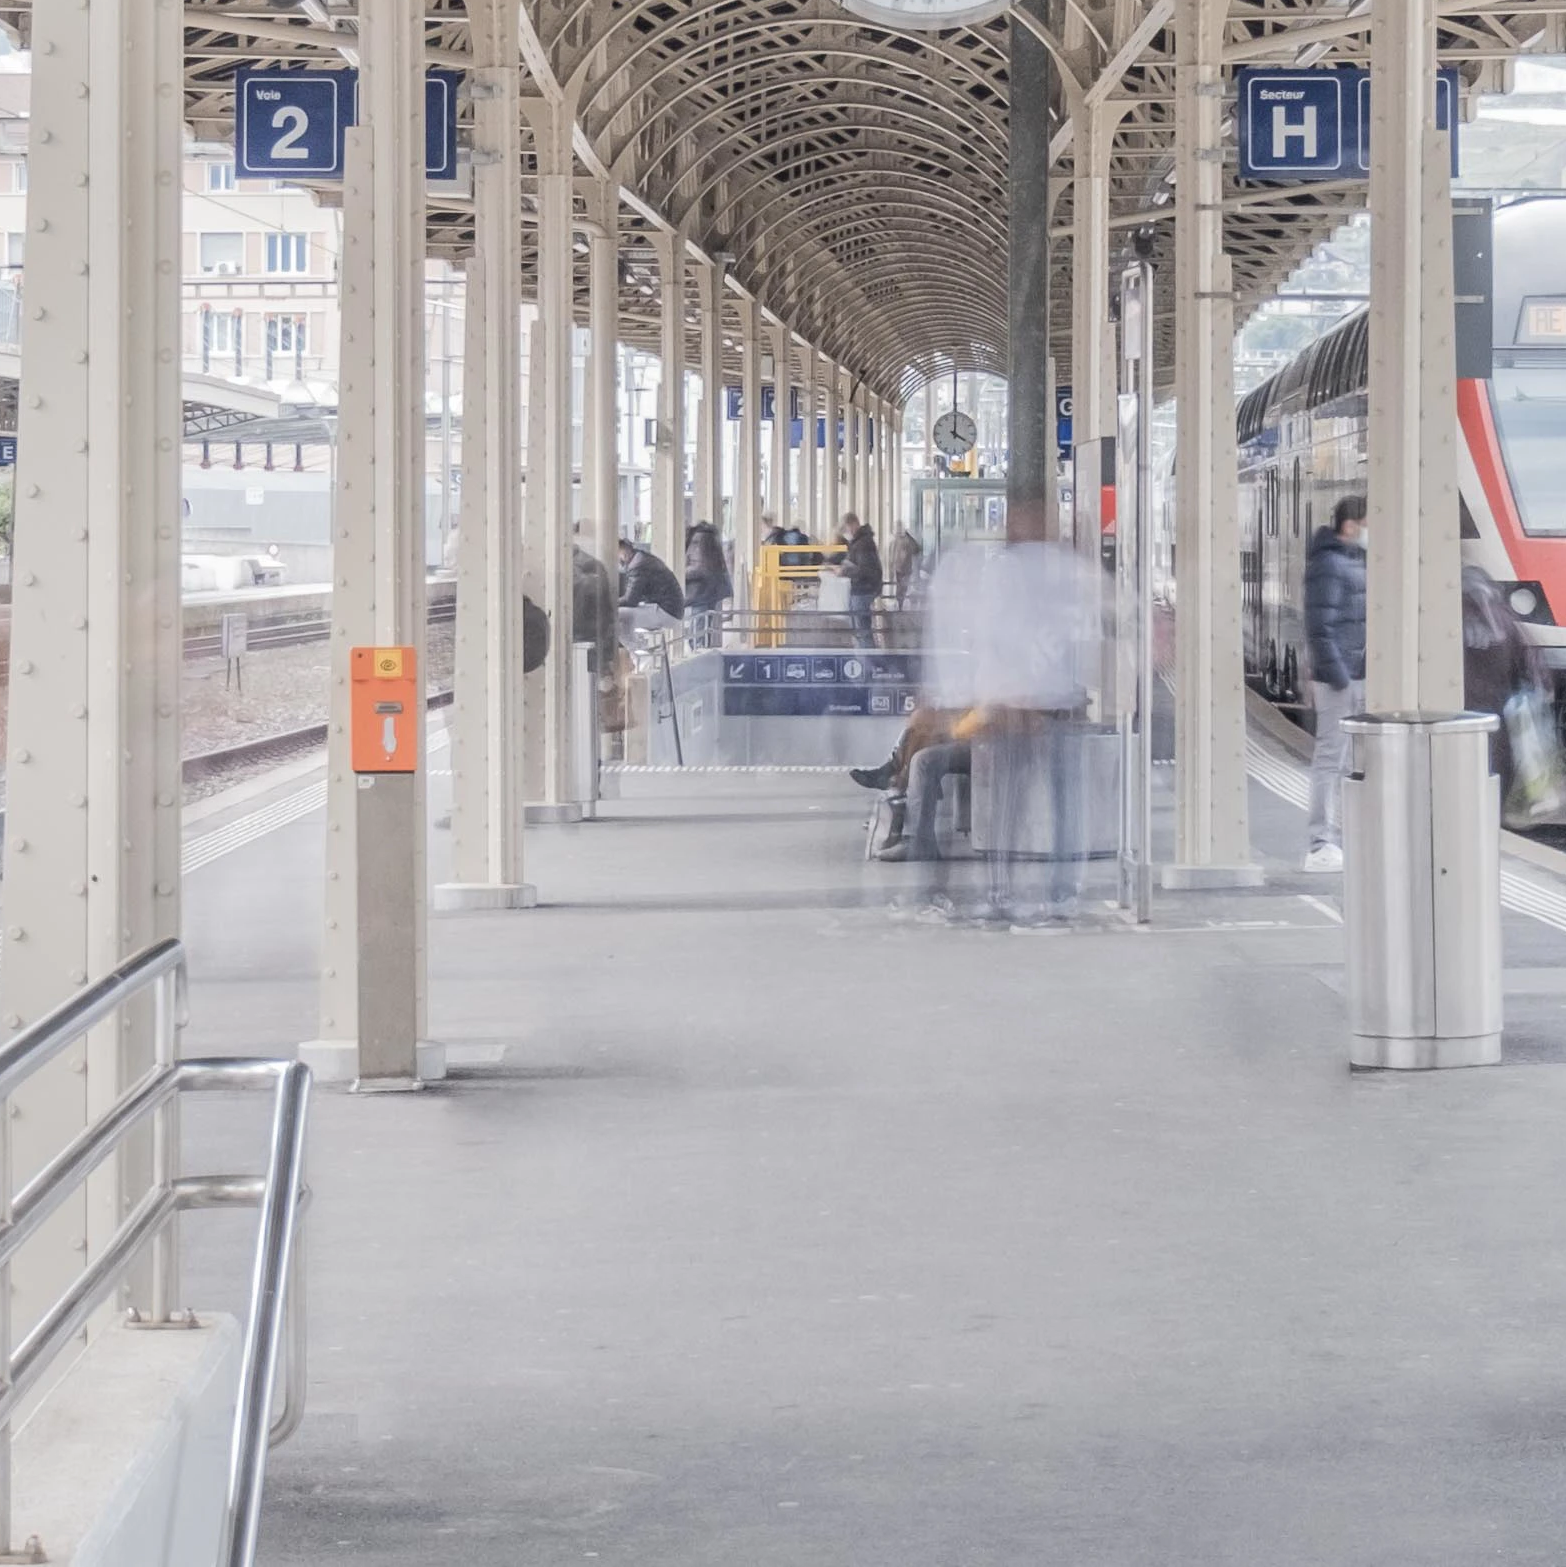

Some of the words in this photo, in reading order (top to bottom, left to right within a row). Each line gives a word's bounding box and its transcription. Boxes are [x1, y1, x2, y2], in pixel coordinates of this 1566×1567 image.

[1259, 89, 1306, 101] Secteur
[271, 106, 309, 159] 2
[1273, 106, 1317, 159] H
[3, 445, 14, 460] E
[763, 664, 771, 679] 1
